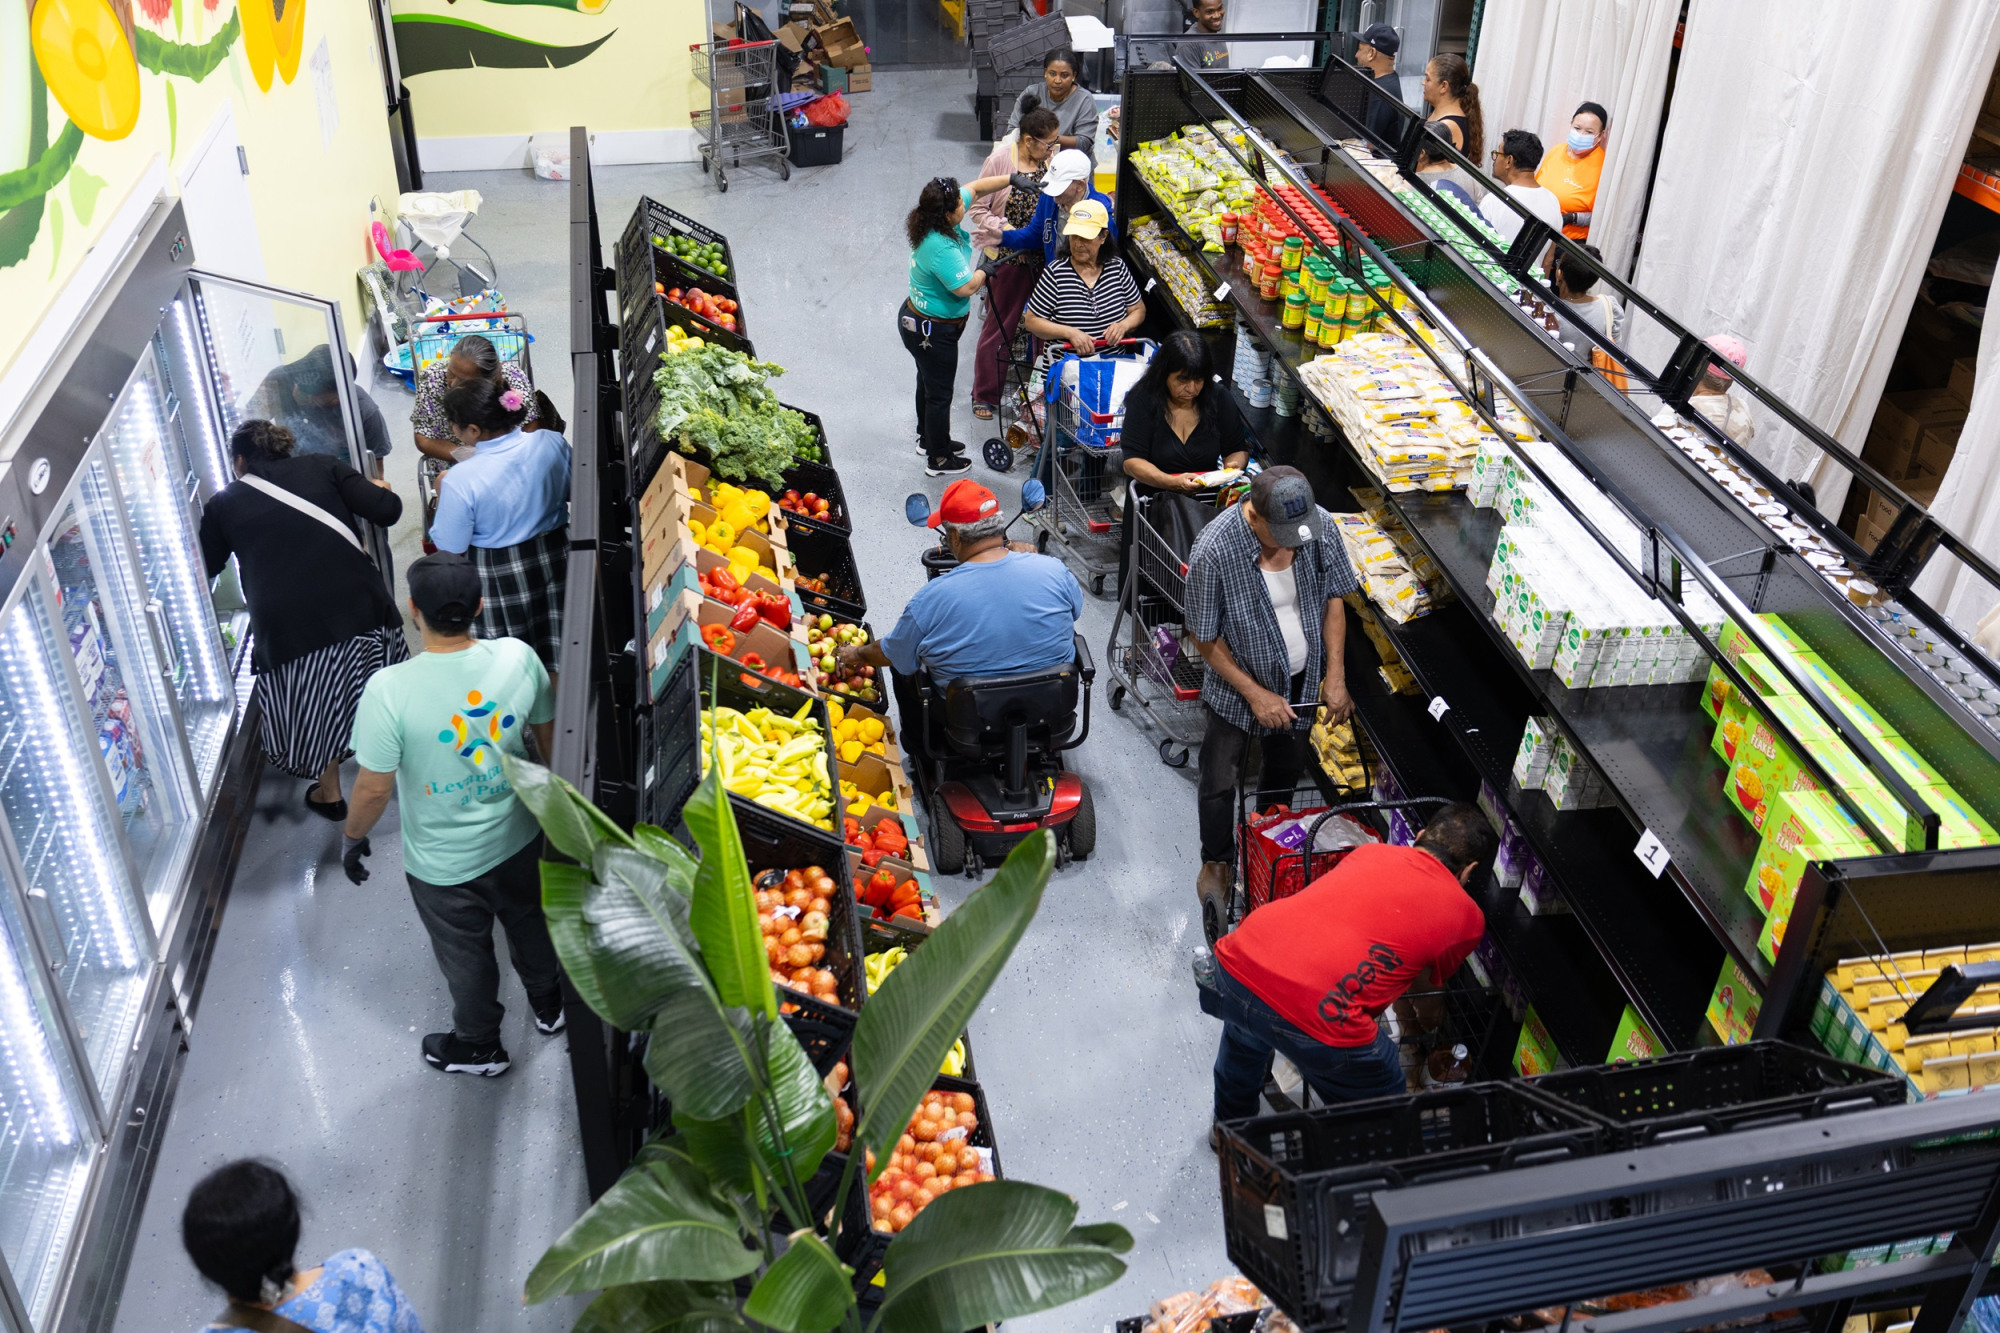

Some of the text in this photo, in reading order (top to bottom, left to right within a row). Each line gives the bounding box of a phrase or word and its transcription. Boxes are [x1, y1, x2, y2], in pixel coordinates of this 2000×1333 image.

[1879, 502, 1893, 516] Food
[1755, 723, 1776, 746] CORN
[1750, 734, 1777, 761] FLAKES
[1797, 768, 1818, 792] CORN
[1781, 821, 1804, 846] CORN
[1643, 845, 1659, 866] 1
[1630, 1029, 1653, 1055] CORN
